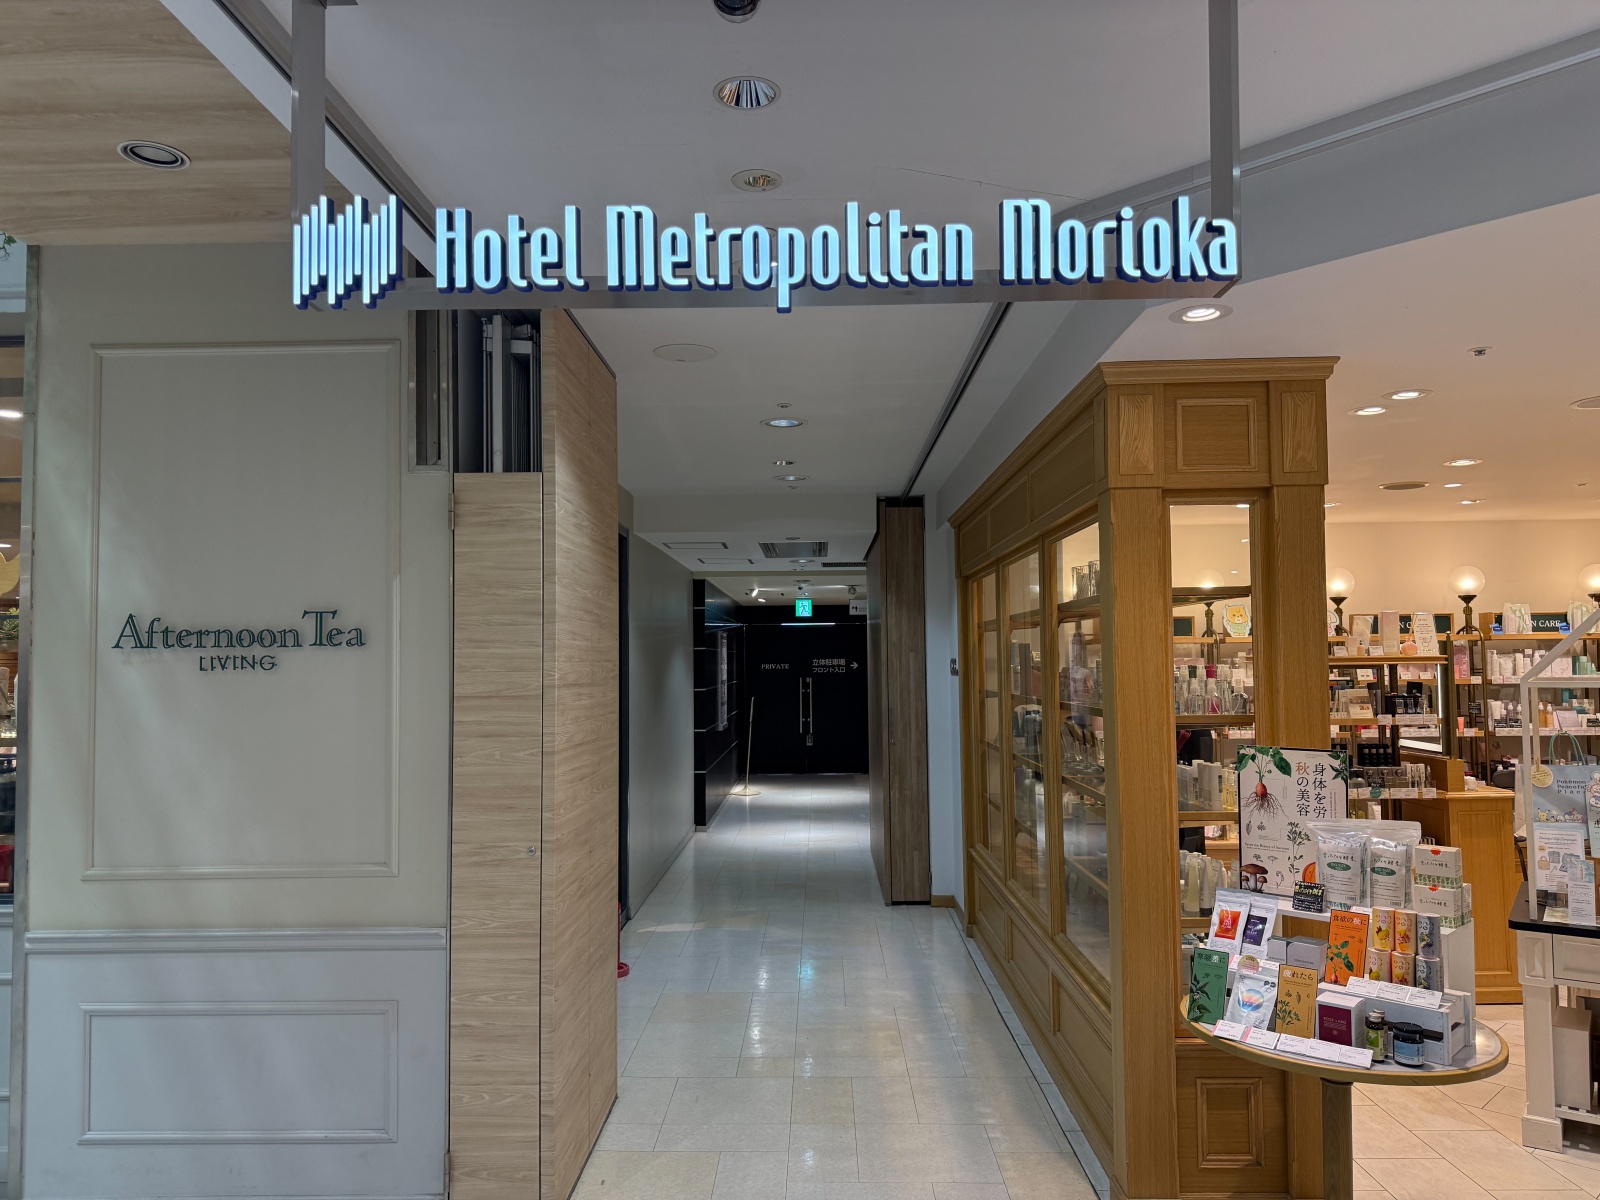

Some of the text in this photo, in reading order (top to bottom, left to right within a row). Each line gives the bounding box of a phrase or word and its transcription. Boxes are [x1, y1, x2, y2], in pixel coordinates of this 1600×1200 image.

[435, 196, 1237, 311] Hotel Metropolitan Morioka
[111, 609, 366, 649] Afternoon Tea
[199, 655, 278, 671] LIVING
[1295, 761, 1310, 817] 秋の美容
